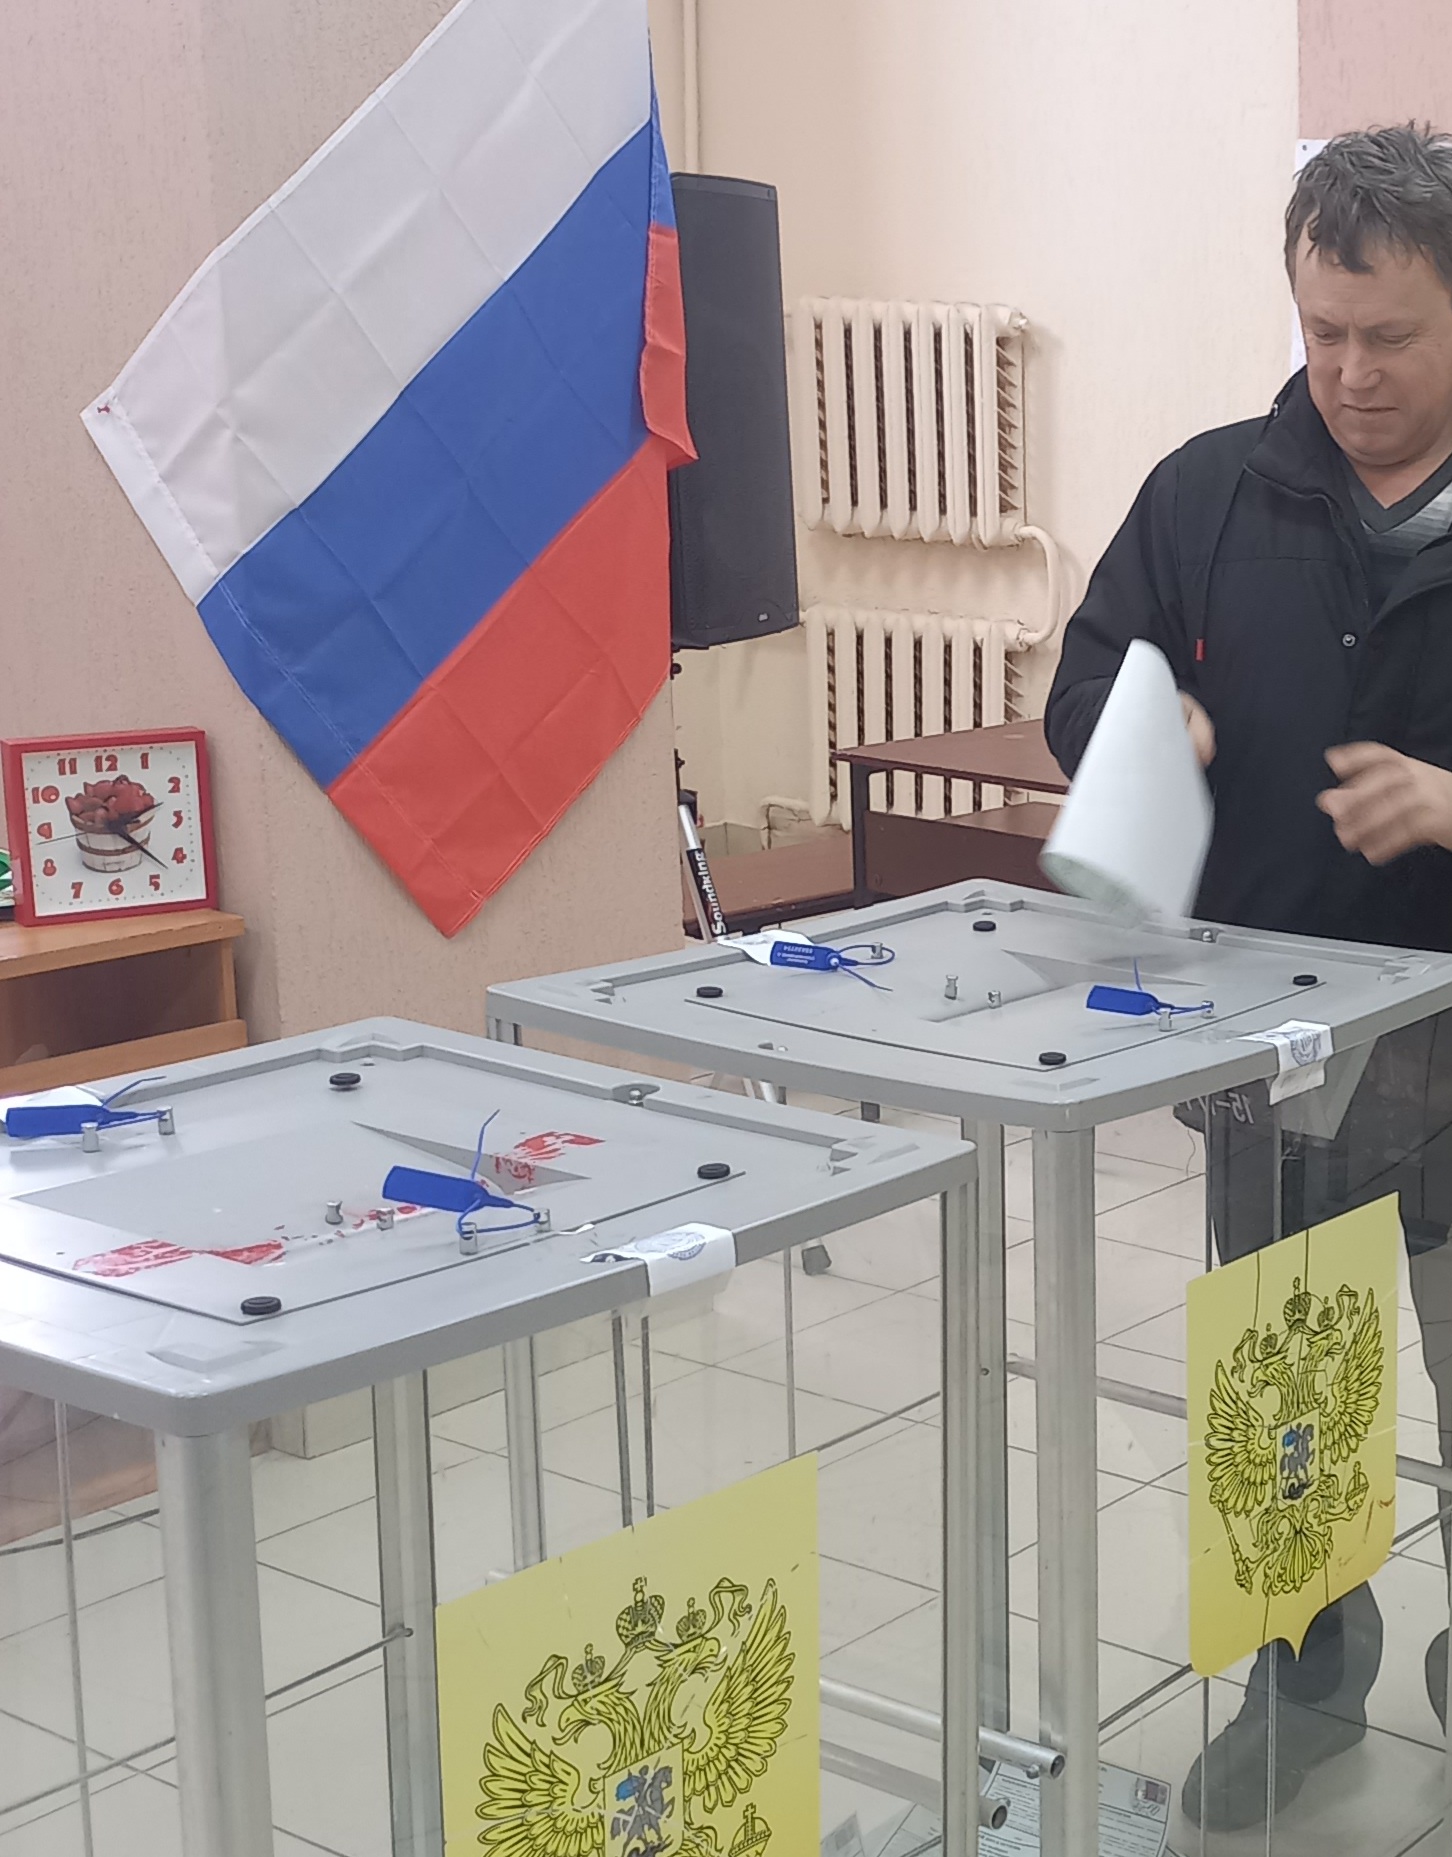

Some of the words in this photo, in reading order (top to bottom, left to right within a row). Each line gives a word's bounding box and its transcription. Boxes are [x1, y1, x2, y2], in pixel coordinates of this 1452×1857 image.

[57, 758, 77, 775] 11
[94, 754, 118, 772] 12
[140, 752, 149, 769] 1
[167, 776, 181, 793] 2
[31, 785, 60, 804] 10
[171, 810, 184, 828] 3
[36, 822, 53, 839] 9
[171, 847, 187, 864] 4
[42, 858, 57, 876] 8
[70, 881, 84, 899] 7
[108, 878, 124, 895] 6
[149, 874, 161, 891] 5
